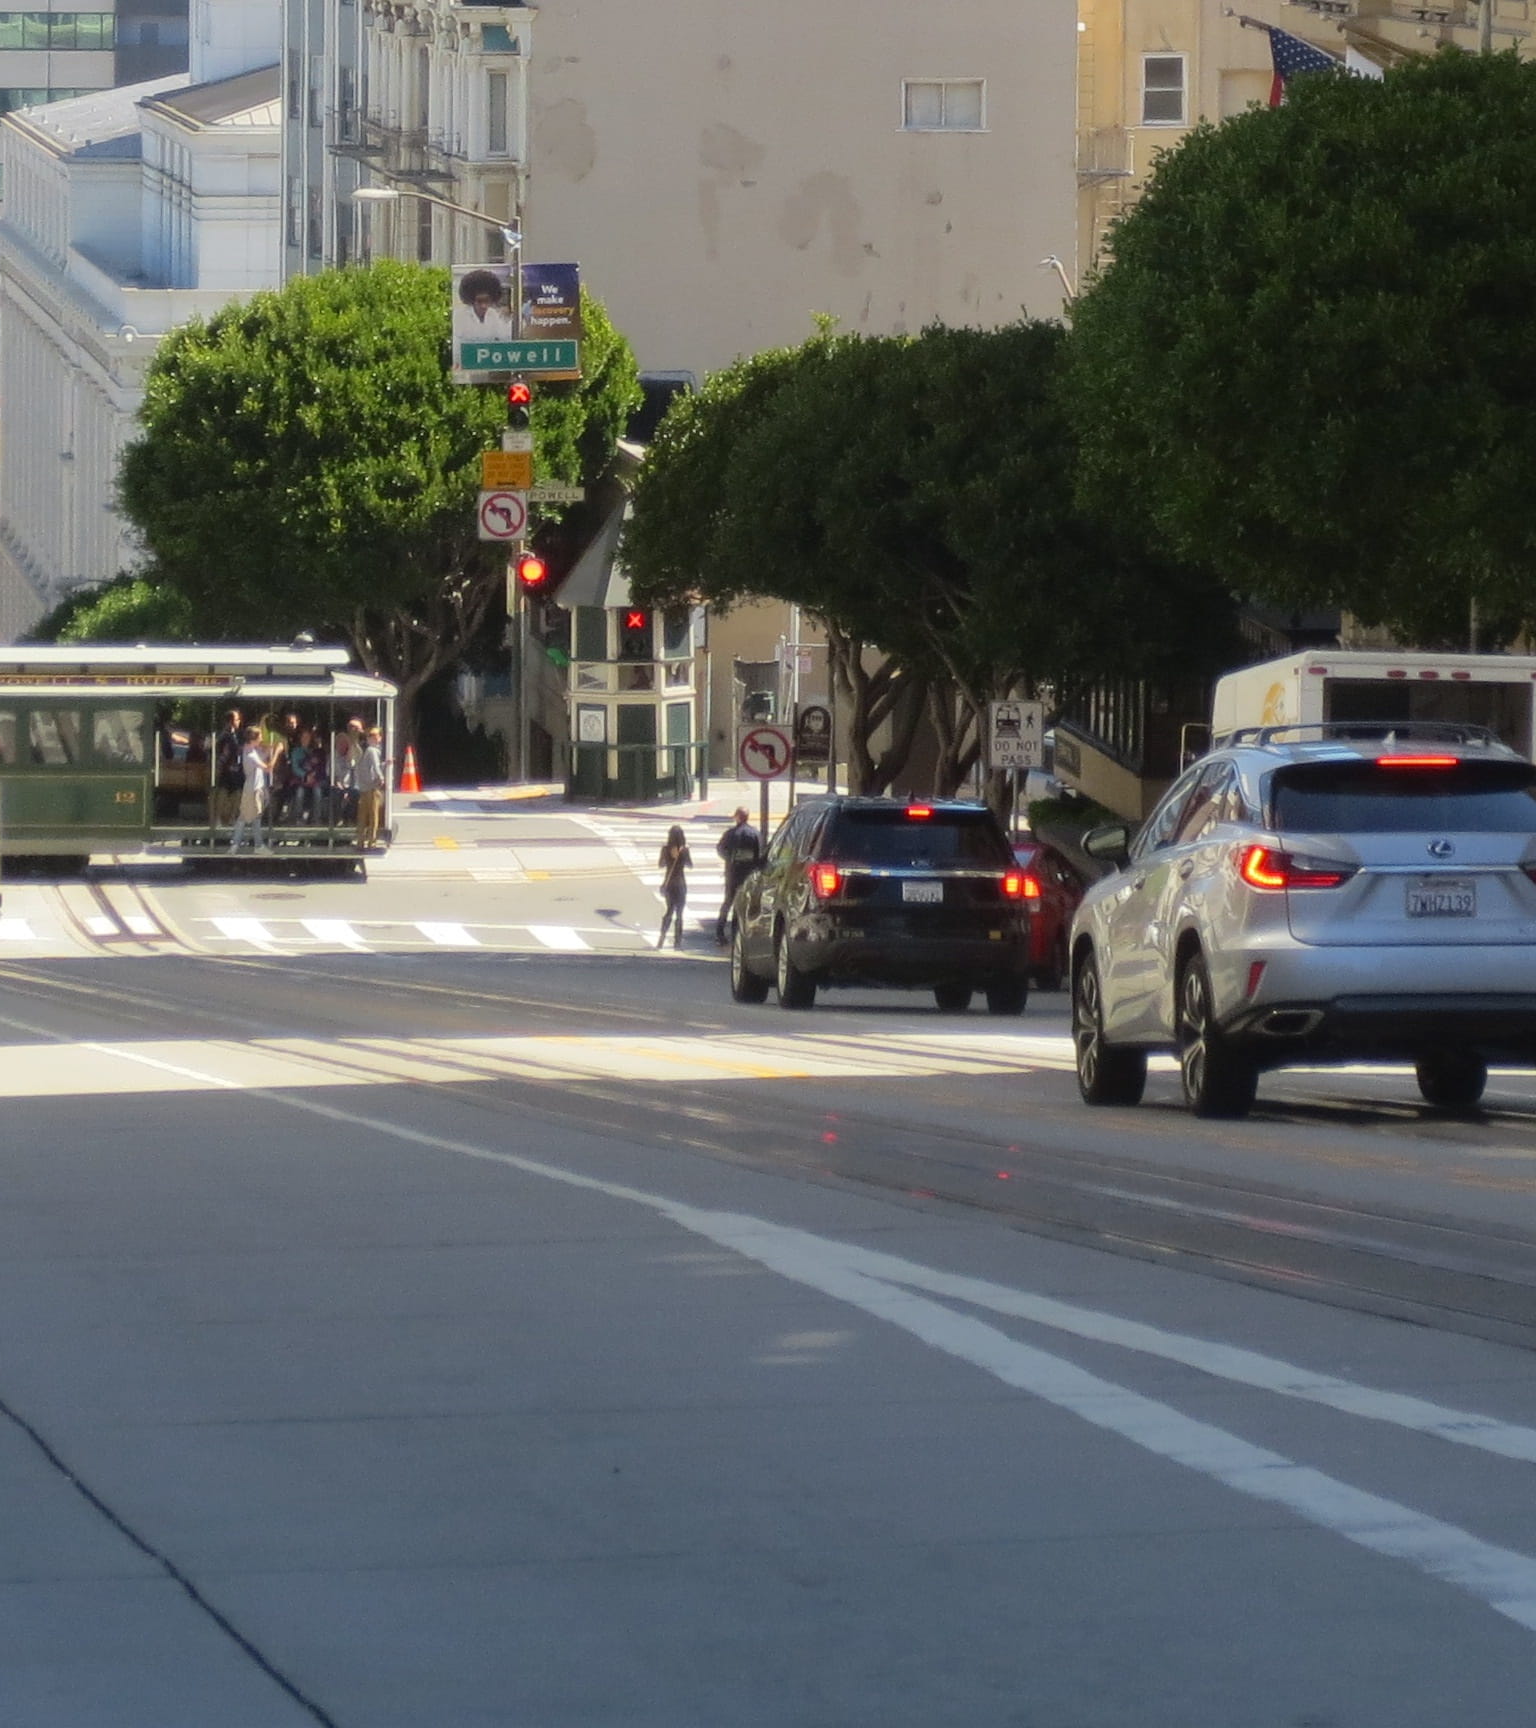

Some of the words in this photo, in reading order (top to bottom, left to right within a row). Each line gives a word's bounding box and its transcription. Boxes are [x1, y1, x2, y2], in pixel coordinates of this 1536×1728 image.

[541, 284, 558, 294] We
[537, 295, 564, 304] make
[530, 316, 572, 327] happen.
[477, 347, 561, 364] Powell
[995, 741, 1010, 752] DO
[1016, 741, 1037, 752] NOT
[1001, 755, 1033, 765] PASS
